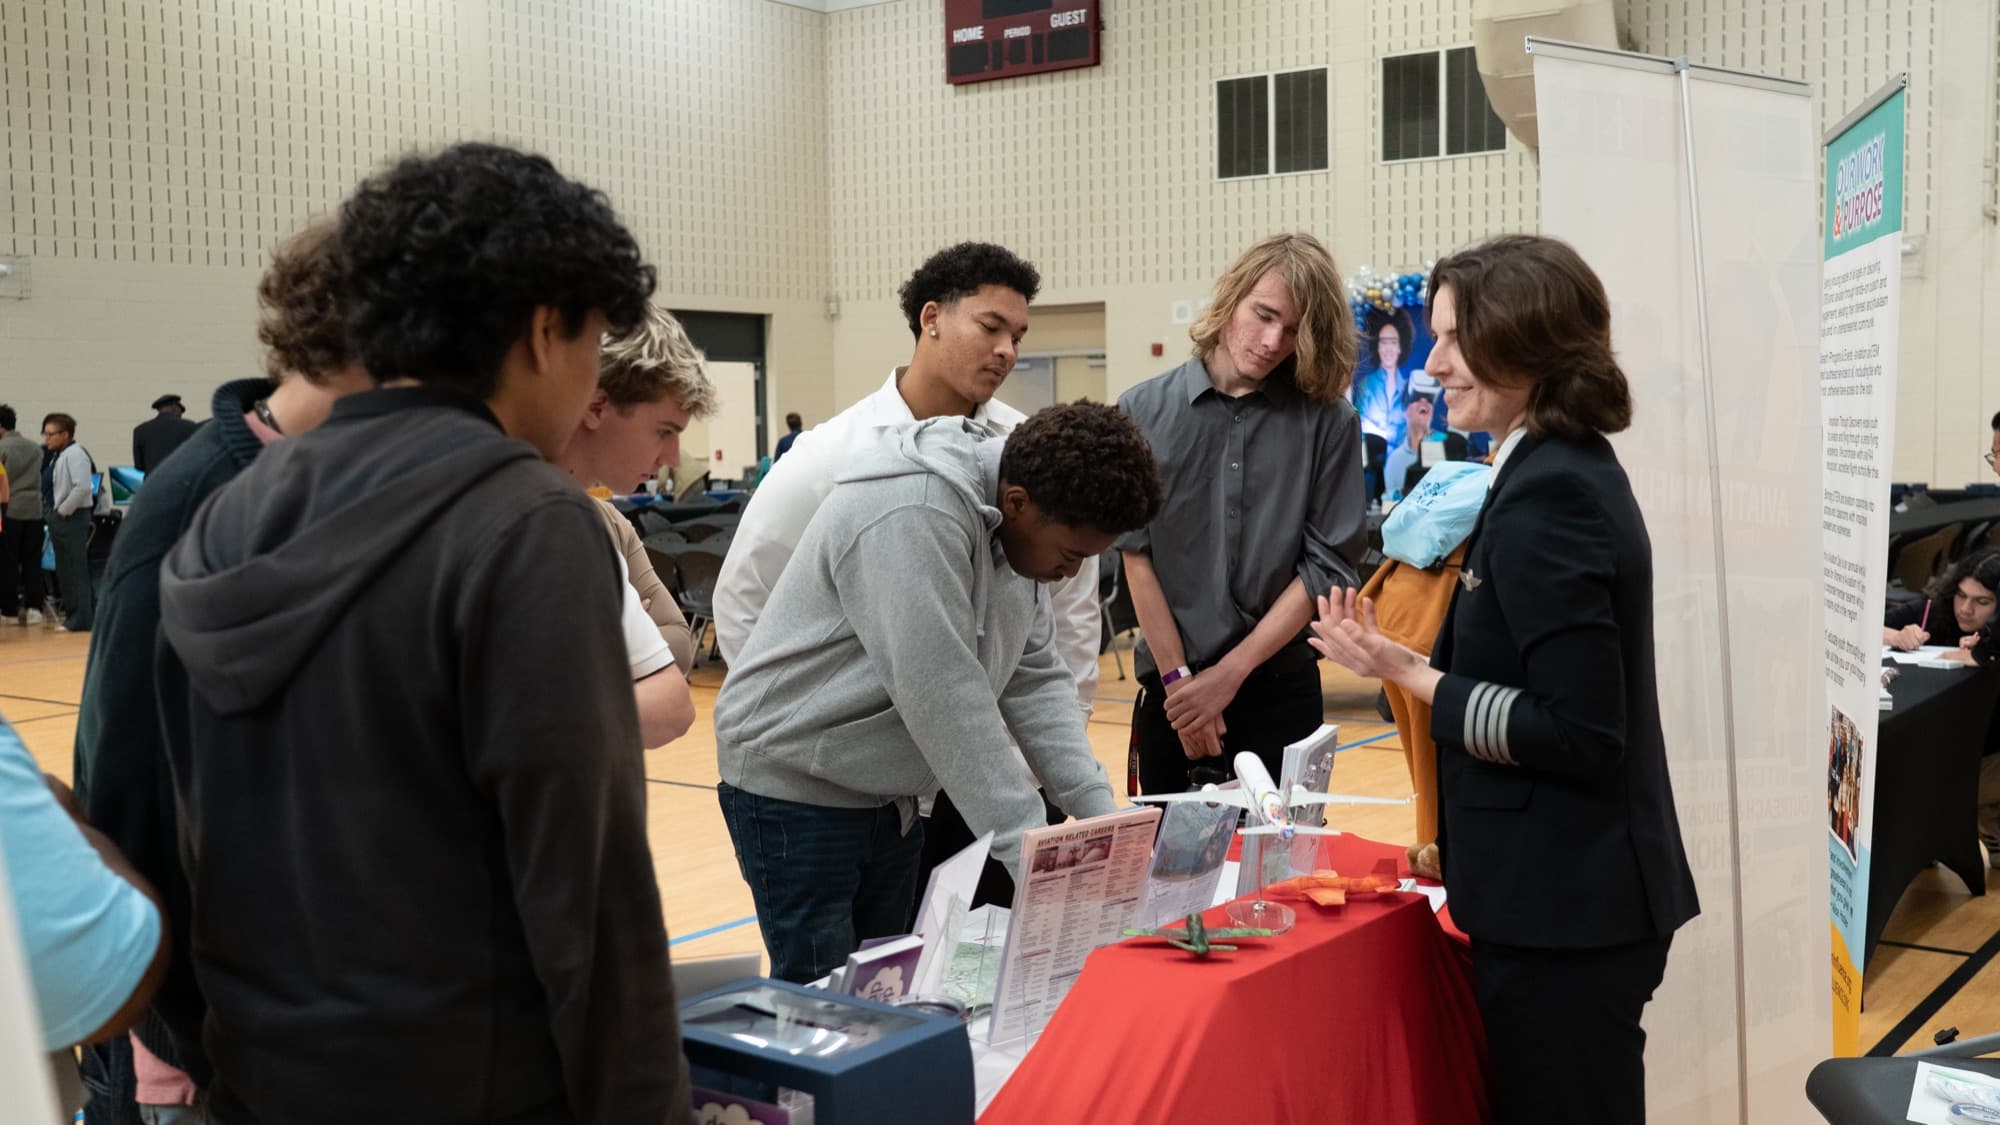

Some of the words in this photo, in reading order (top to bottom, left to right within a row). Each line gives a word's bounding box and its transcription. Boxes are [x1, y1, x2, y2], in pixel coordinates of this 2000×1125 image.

[1050, 9, 1087, 28] GUEST
[953, 25, 984, 43] HOME
[1004, 26, 1031, 39] PERIOD
[1836, 156, 1855, 196] OUR
[1855, 134, 1885, 185] WORK
[1834, 204, 1841, 236] &
[1843, 180, 1883, 232] PURPOSE
[1037, 835, 1064, 848] AVIATION
[1065, 830, 1089, 841] RELATED
[1090, 824, 1115, 837] CAREERS
